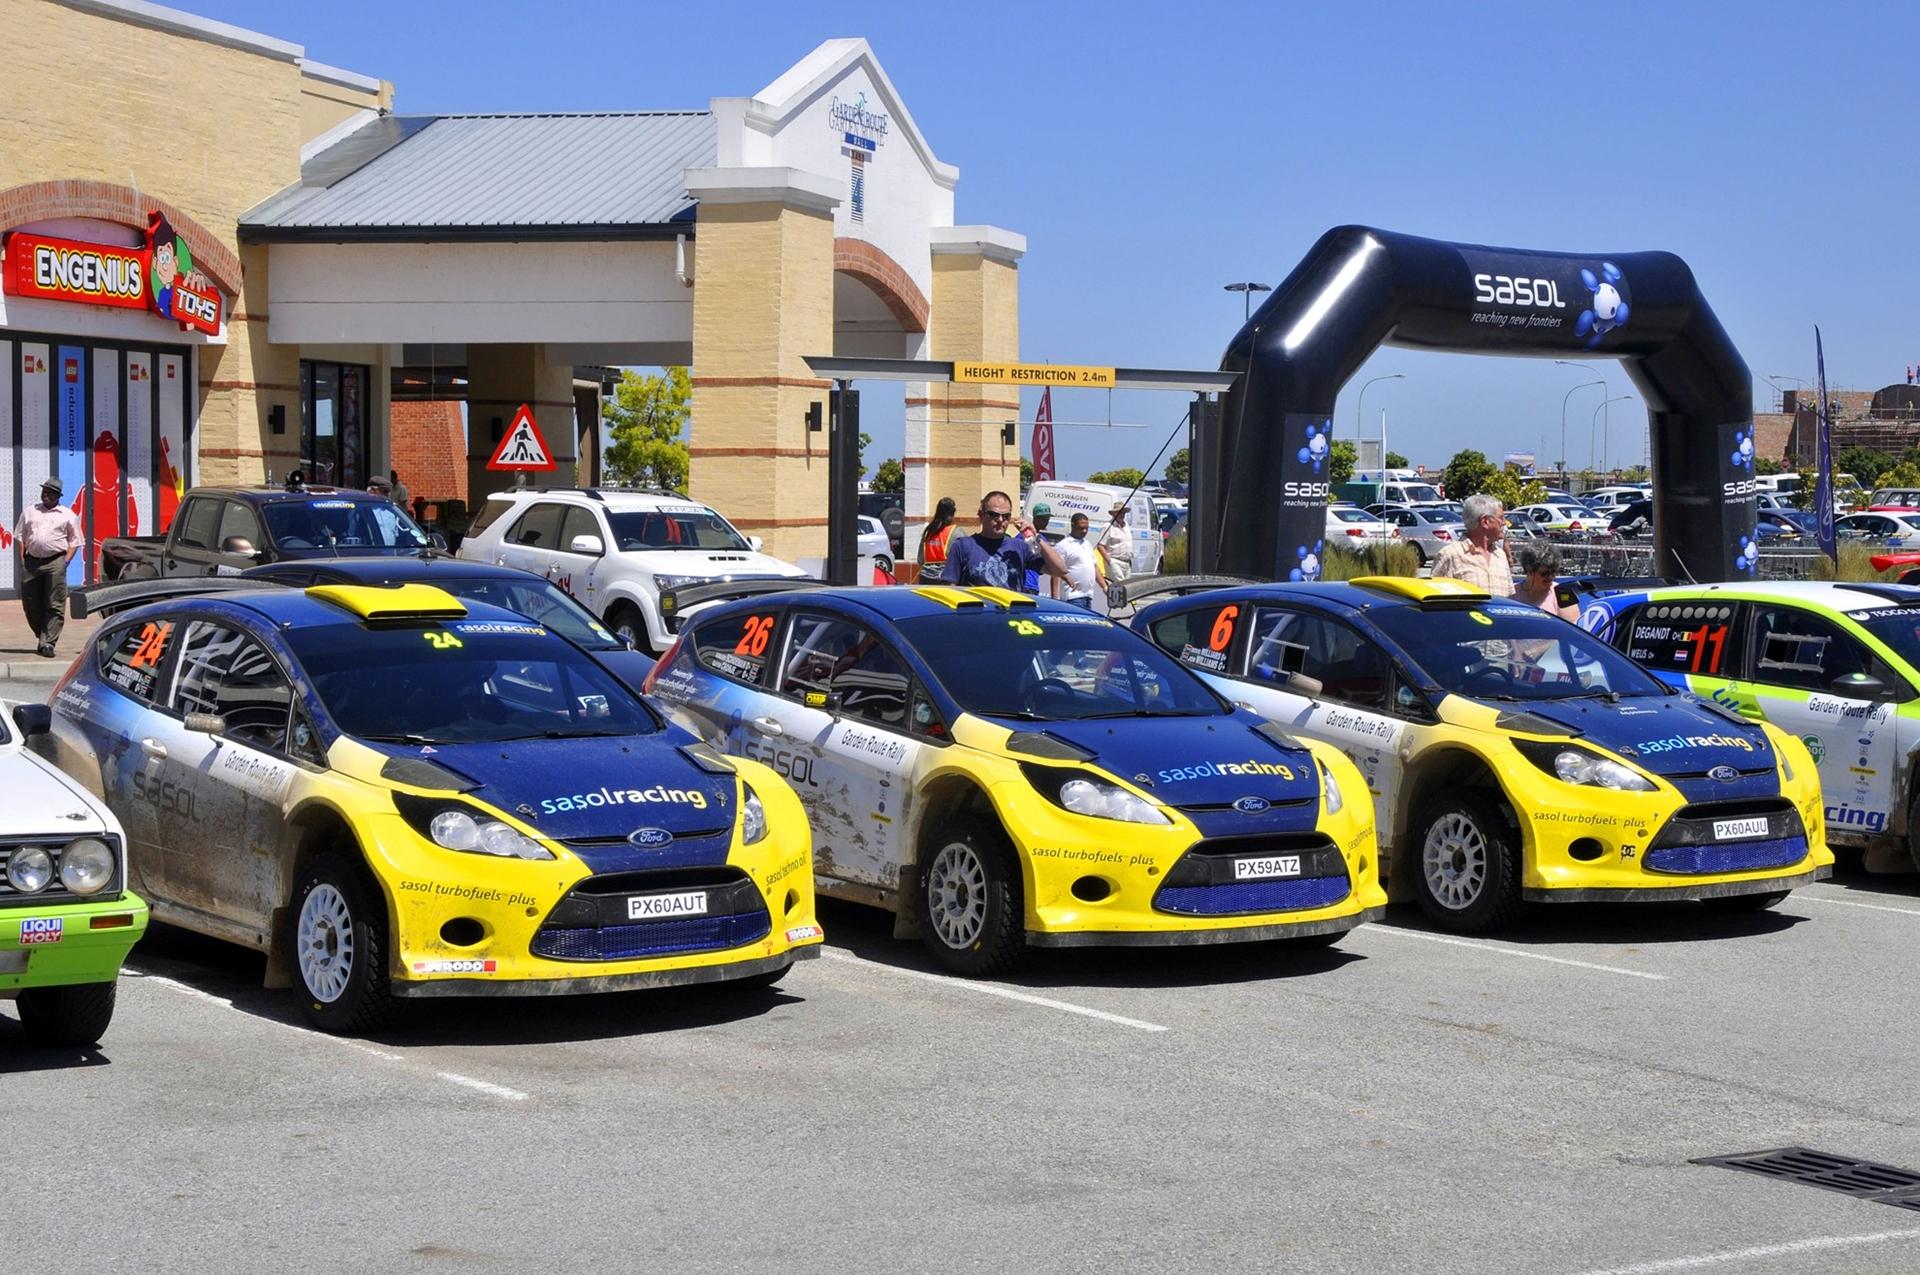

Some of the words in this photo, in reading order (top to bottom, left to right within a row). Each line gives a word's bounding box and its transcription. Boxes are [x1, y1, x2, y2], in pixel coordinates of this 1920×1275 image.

[36, 247, 142, 297] ENGENIUS
[176, 287, 217, 323] TOYS
[1471, 311, 1508, 327] reaching
[1509, 314, 1527, 325] new
[1525, 313, 1563, 328] frontiers
[964, 366, 1004, 379] HEIGHT
[1011, 368, 1076, 382] RESTRICTION
[1082, 372, 1107, 383] 2.4m
[68, 387, 77, 457] education
[1044, 491, 1089, 502] VOLKSWAGEN
[1061, 500, 1101, 513] Racing
[734, 616, 775, 657] 26
[1209, 604, 1239, 651] 6
[1635, 626, 1671, 640] DEGANDT
[129, 622, 172, 668] 24
[423, 631, 464, 649] 24
[1690, 623, 1728, 673] 11
[1809, 697, 1839, 715] Garden
[1839, 701, 1866, 719] Route
[1866, 703, 1888, 725] Rally
[1325, 710, 1353, 730] Garden
[1352, 716, 1376, 735] Route
[1375, 721, 1396, 743] Rally
[841, 729, 868, 750] Garden
[865, 735, 888, 757] Route
[886, 741, 907, 765] Rally
[1637, 733, 1754, 754] sasolracing
[224, 750, 251, 773] Garden
[250, 758, 269, 782] Route
[267, 765, 287, 792] Rally
[1158, 759, 1296, 784] sasolracing
[541, 785, 708, 814] sasolracing
[1534, 811, 1561, 822] sasol
[1562, 814, 1617, 826] turbofuels
[1623, 817, 1646, 828] plus
[1715, 822, 1767, 837] PX60AUU
[1032, 847, 1062, 858] sasol
[1063, 849, 1123, 863] turbofuels
[1129, 854, 1155, 867] plus
[1237, 859, 1299, 876] PX59ATZ
[400, 880, 434, 893] sasol
[435, 885, 502, 901] turbofuels
[507, 893, 537, 906] plus
[631, 895, 704, 915] PX60AUT
[22, 919, 61, 933] LIQUI
[22, 931, 61, 943] MOLY
